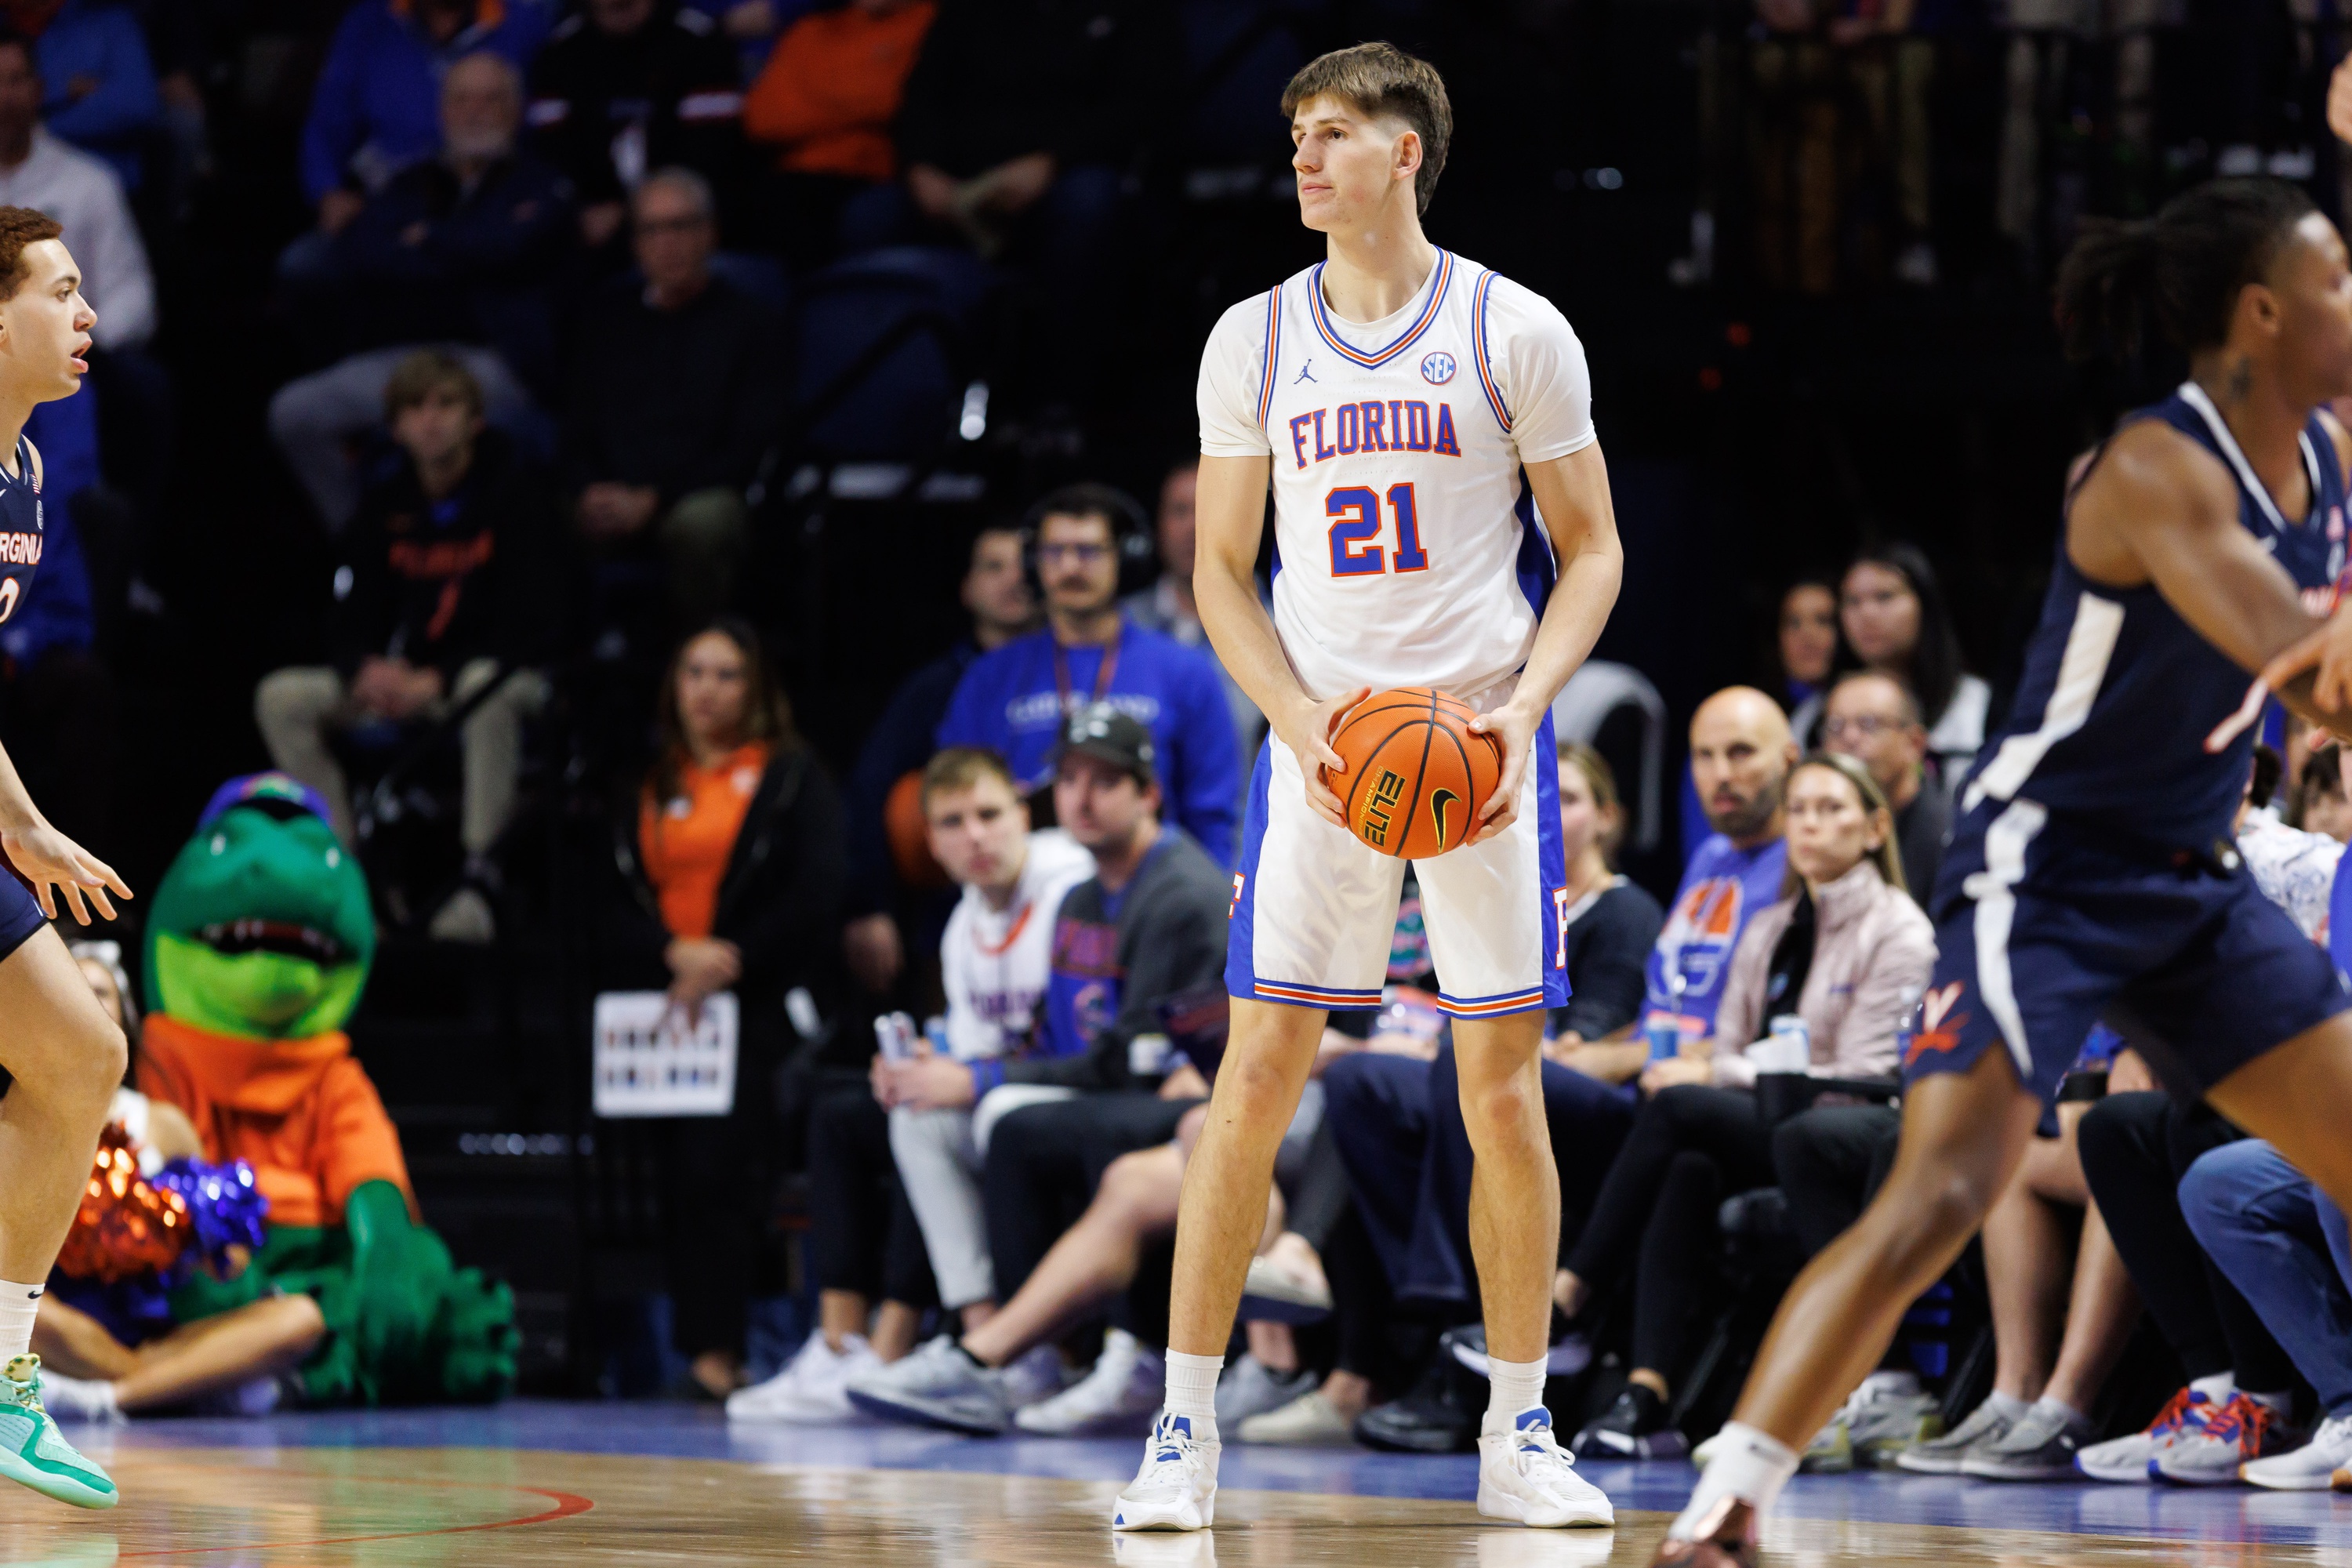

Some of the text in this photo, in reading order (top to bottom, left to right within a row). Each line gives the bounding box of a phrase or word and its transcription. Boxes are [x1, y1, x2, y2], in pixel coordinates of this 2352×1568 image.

[1422, 353, 1455, 384] SEC
[1289, 400, 1461, 470] FLORIDA
[1325, 482, 1429, 578] 21
[1364, 770, 1406, 847] ELITE
